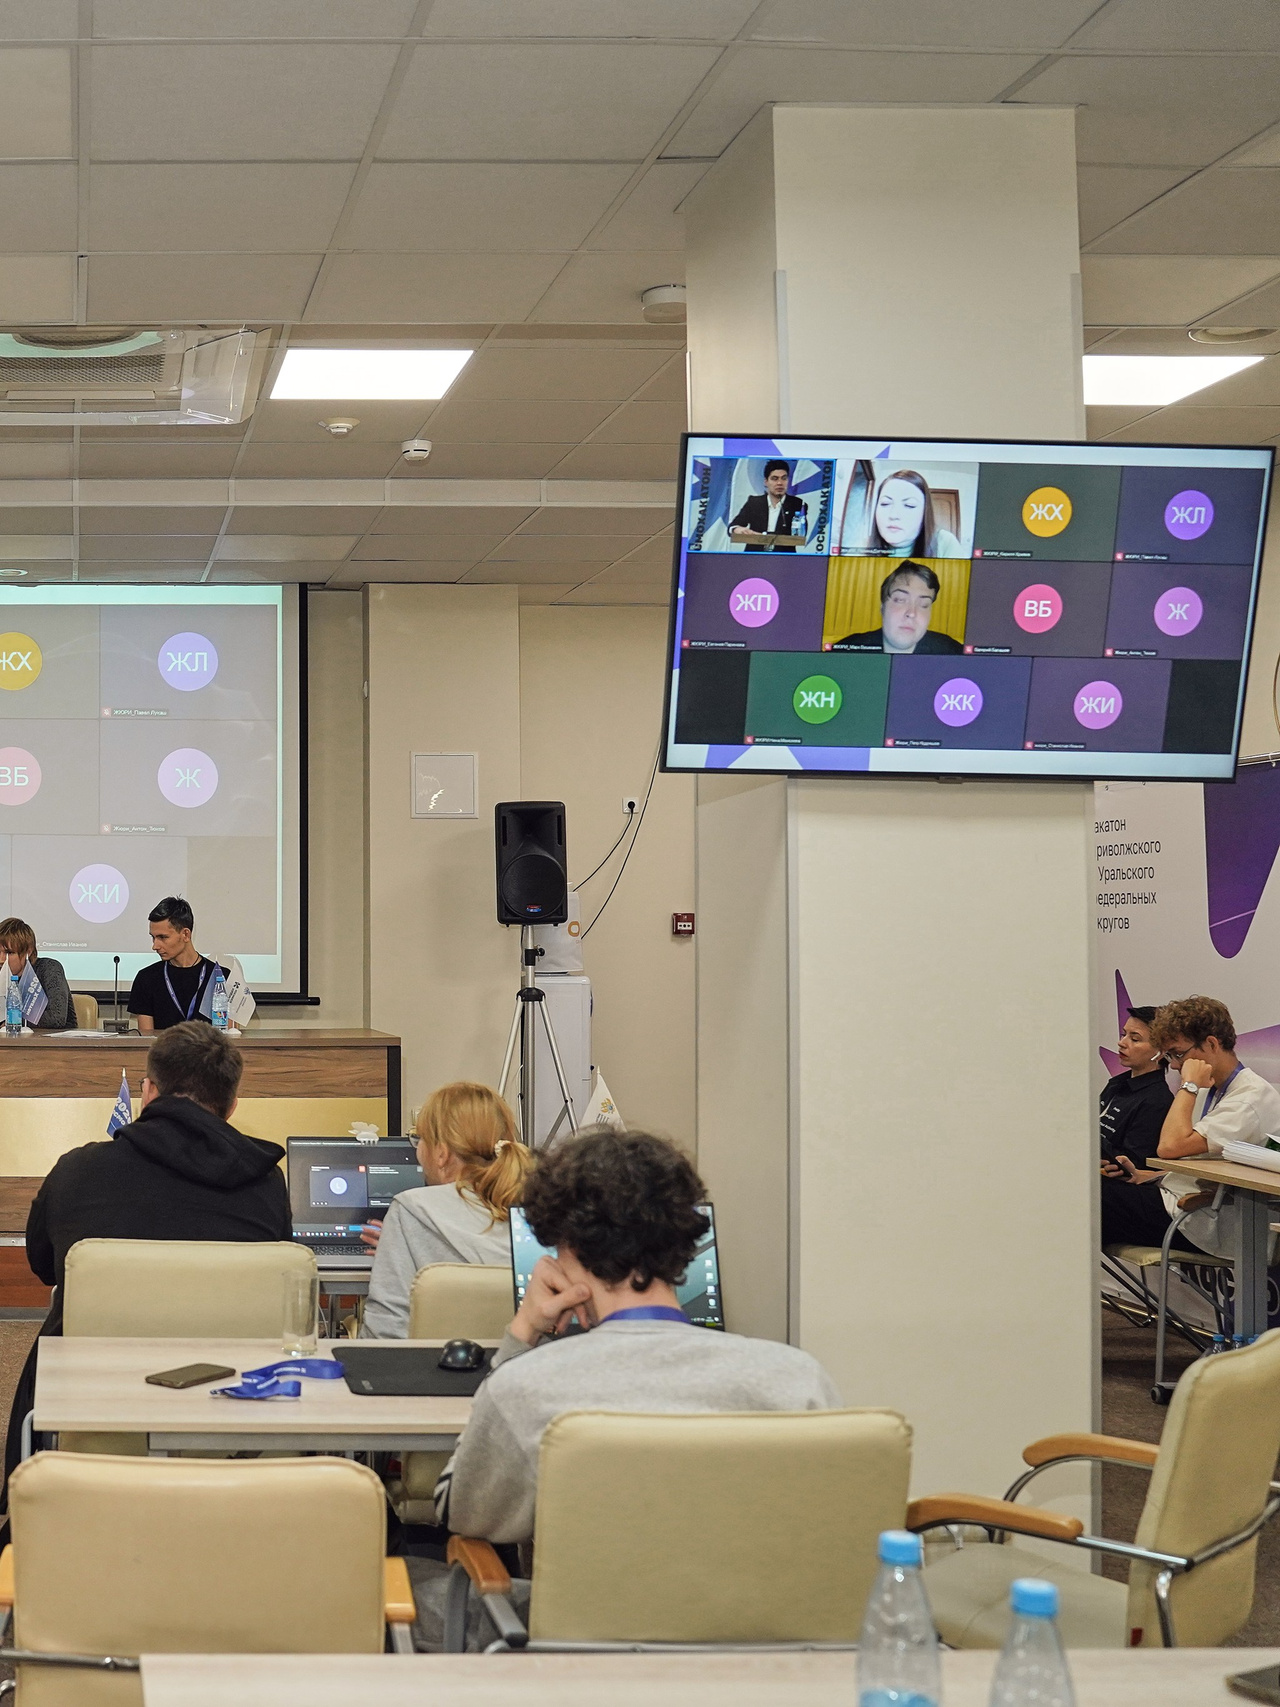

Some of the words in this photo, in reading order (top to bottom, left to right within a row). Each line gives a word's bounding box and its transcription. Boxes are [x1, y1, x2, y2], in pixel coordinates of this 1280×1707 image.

[1029, 503, 1063, 521] ЖХ
[1171, 506, 1206, 524] ЖЛ
[735, 594, 772, 612] ЖП
[1024, 600, 1051, 617] ВБ
[1167, 604, 1189, 621] Ж
[167, 652, 208, 672] ЖЛ
[800, 692, 834, 709] ЖН
[941, 695, 975, 712] ЖК
[1079, 696, 1115, 714] ЖИ
[175, 768, 202, 788] Ж
[1094, 819, 1126, 833] акатон
[1096, 841, 1161, 861] риволжского
[1097, 866, 1155, 884] Уральского
[77, 883, 120, 904] ЖИ
[1097, 892, 1157, 908] едеральных
[1097, 917, 1129, 933] кругов
